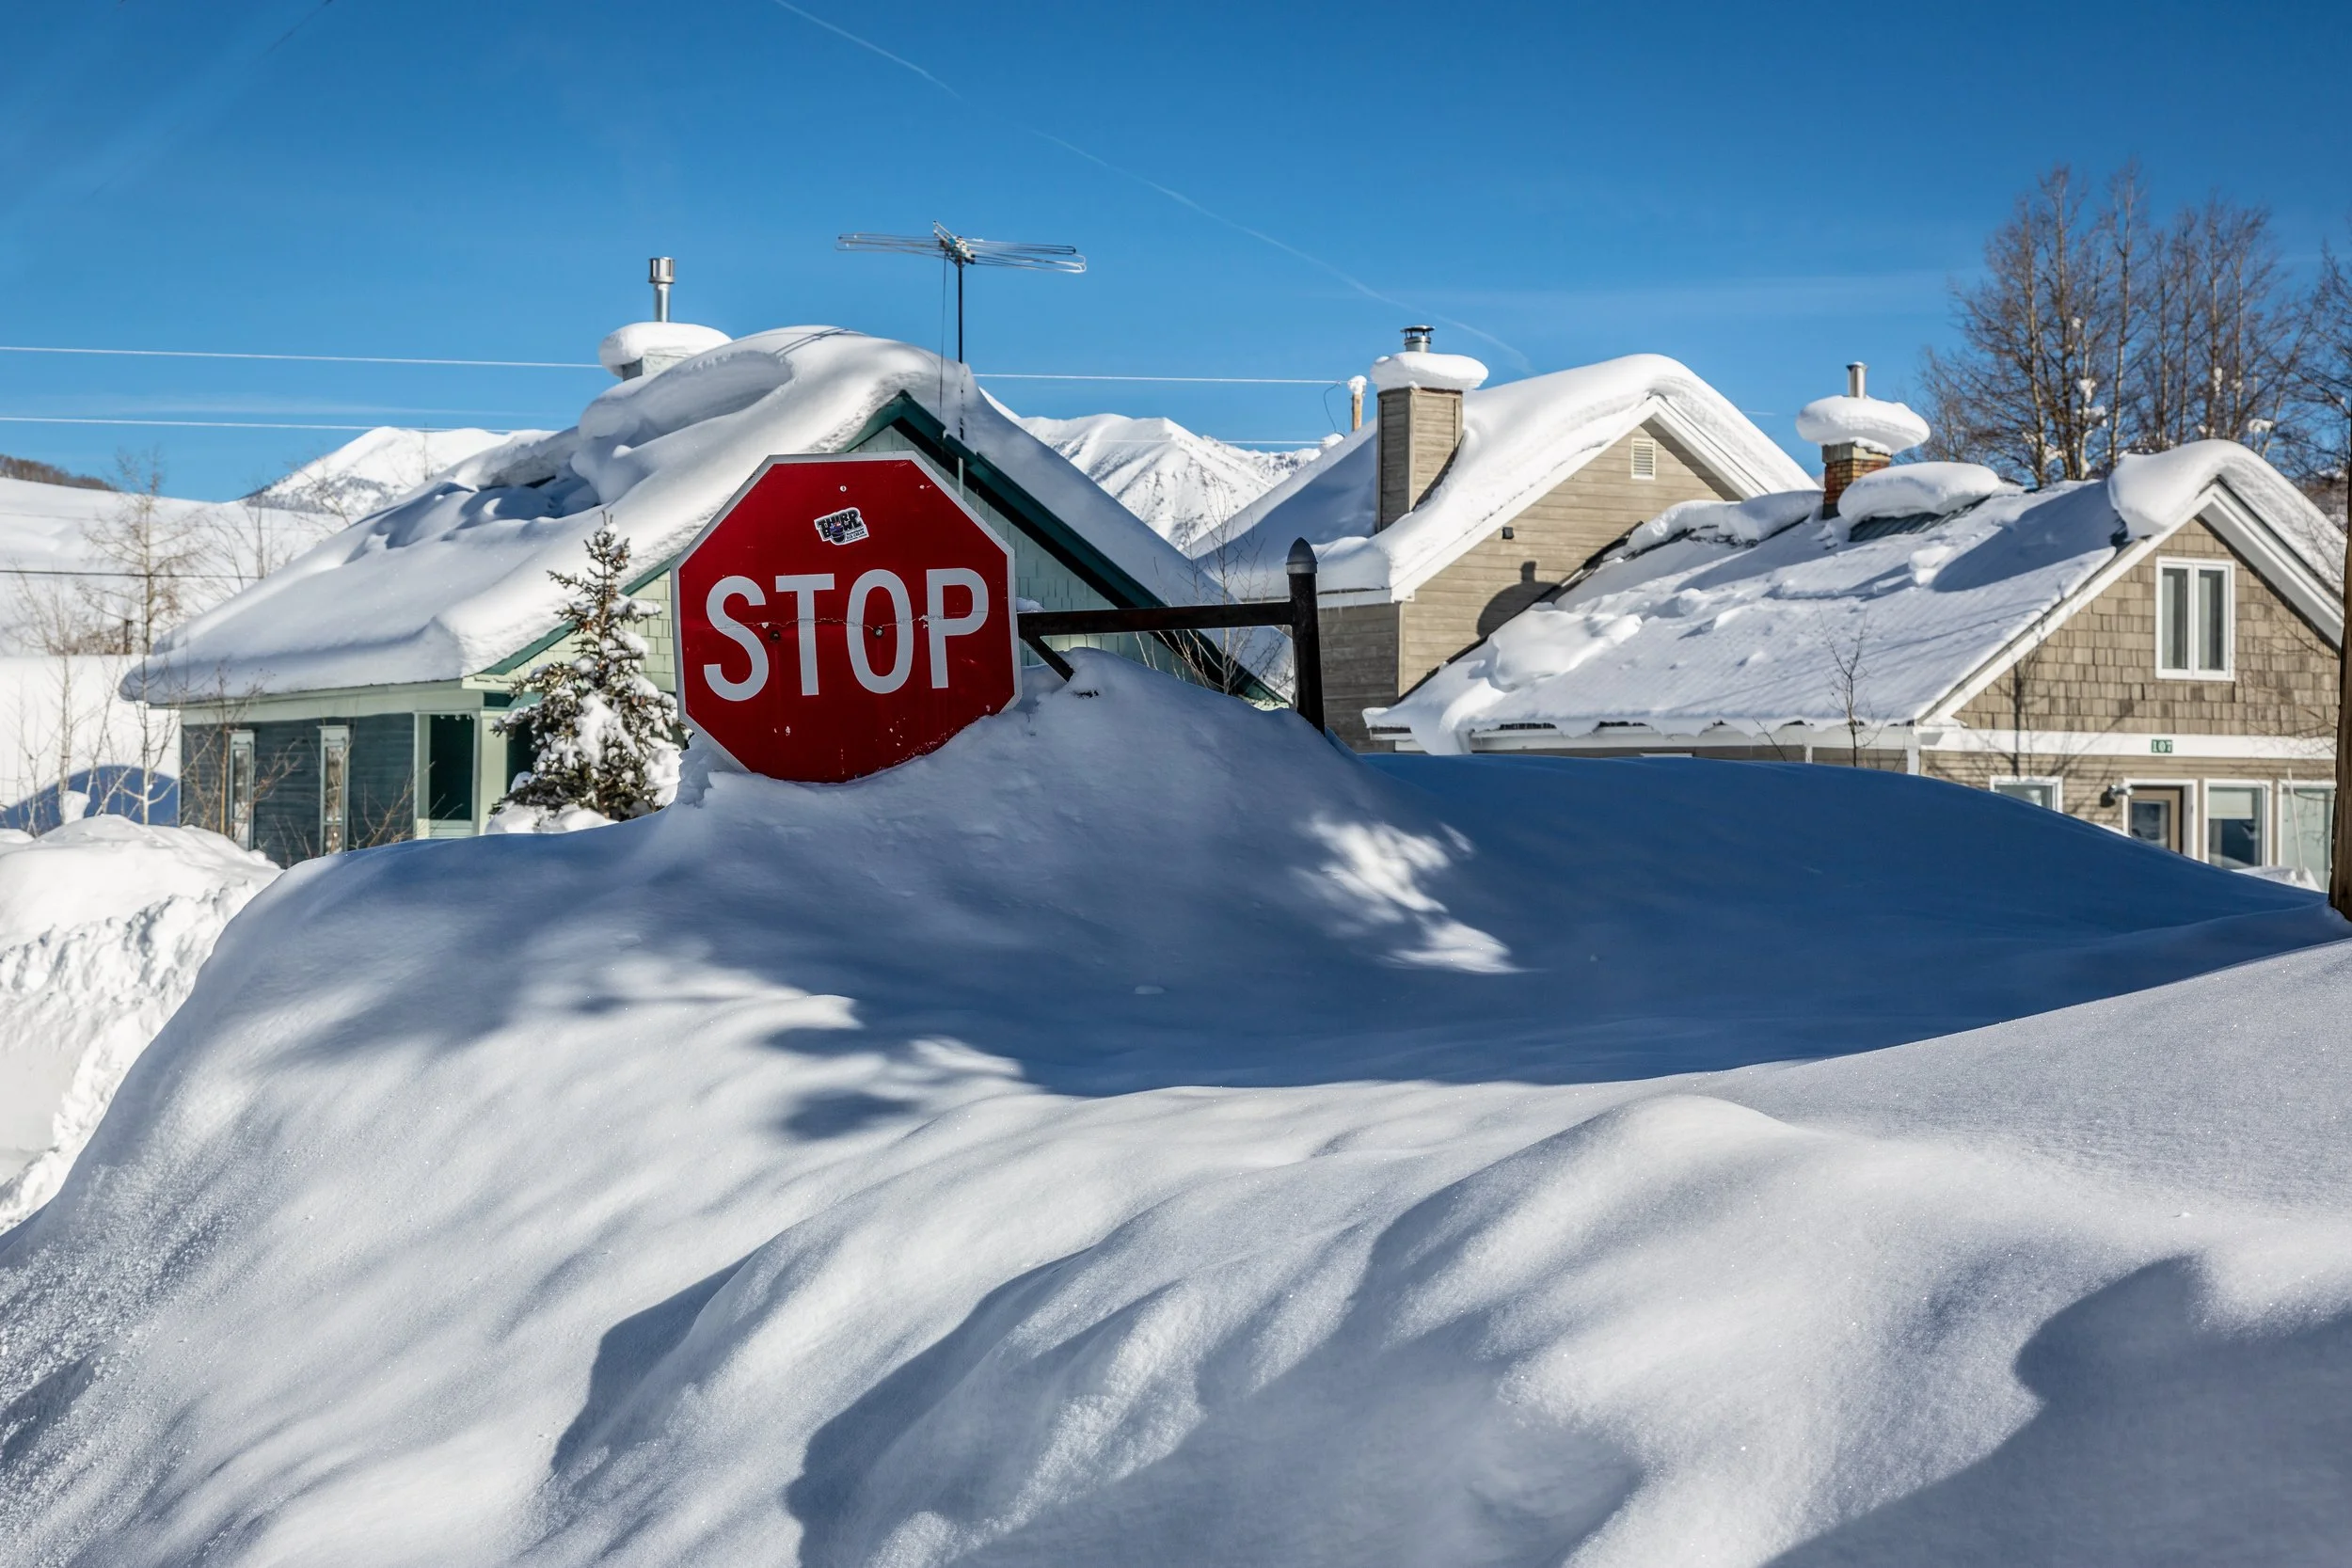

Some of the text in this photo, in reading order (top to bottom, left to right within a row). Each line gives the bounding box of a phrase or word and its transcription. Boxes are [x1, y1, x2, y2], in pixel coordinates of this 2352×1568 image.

[816, 509, 860, 528] THIRD
[704, 567, 989, 702] STOP
[2153, 740, 2171, 752] 107
